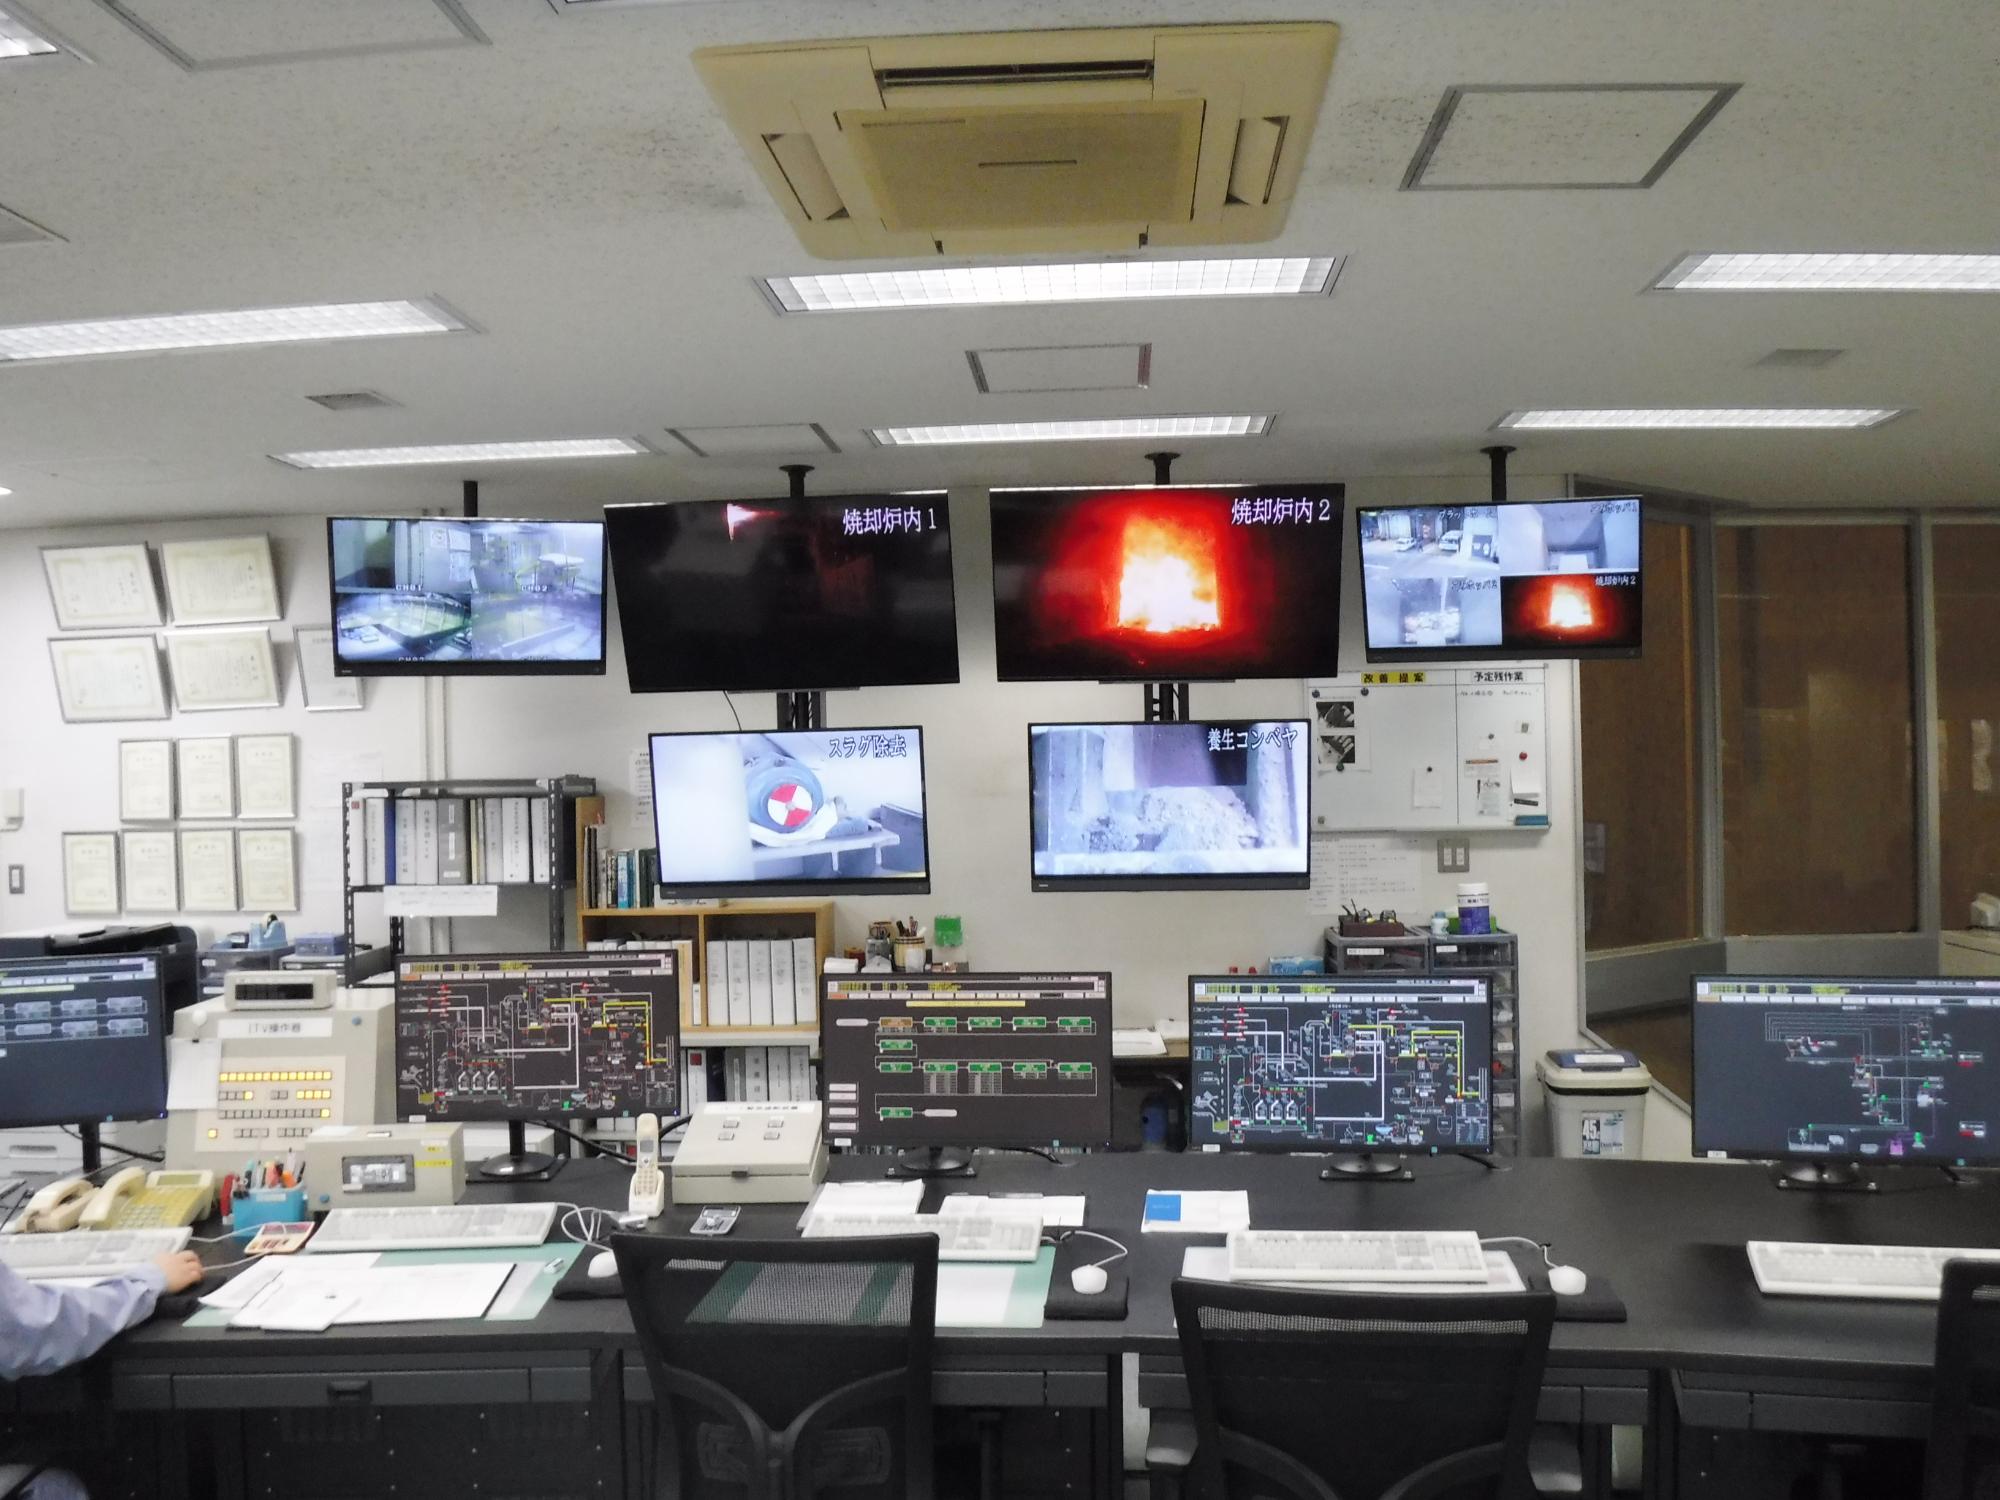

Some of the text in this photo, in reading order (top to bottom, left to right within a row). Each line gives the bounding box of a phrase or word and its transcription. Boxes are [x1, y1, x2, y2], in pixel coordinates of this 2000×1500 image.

[1473, 671, 1524, 683] 予定残作業
[828, 733, 907, 759] スラグ除去
[1207, 727, 1298, 751] 養生コンベヤ
